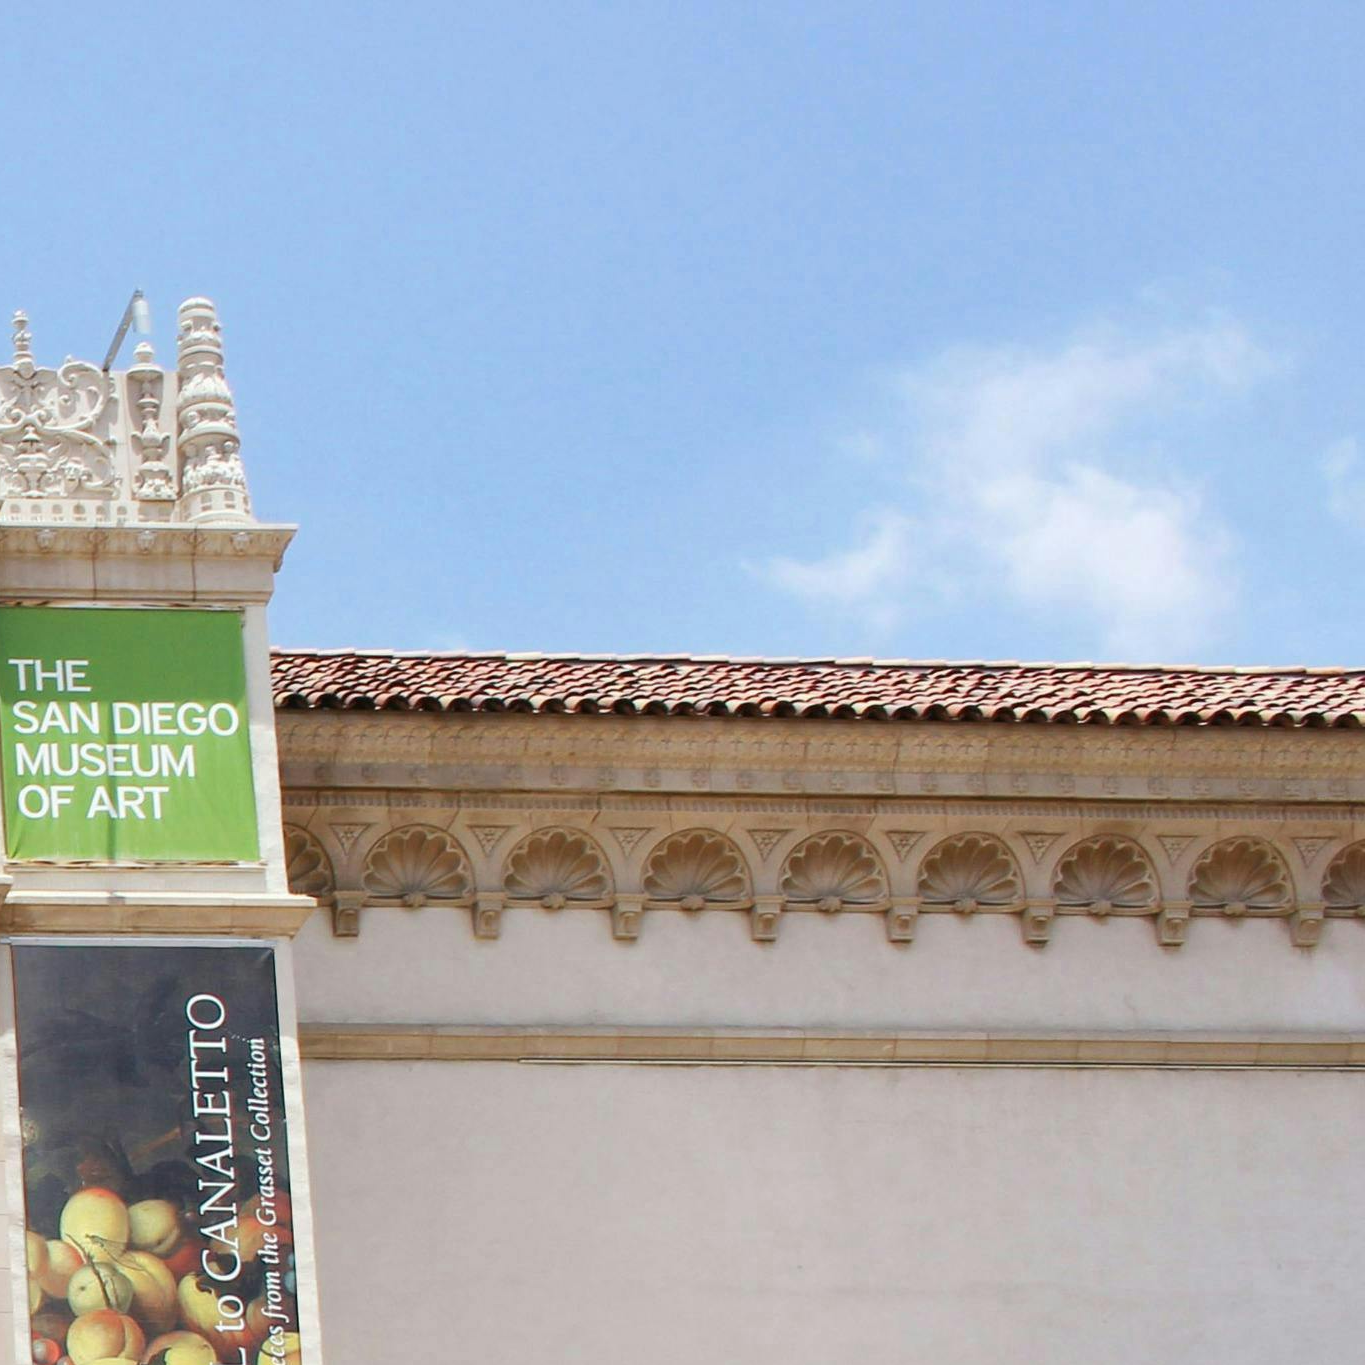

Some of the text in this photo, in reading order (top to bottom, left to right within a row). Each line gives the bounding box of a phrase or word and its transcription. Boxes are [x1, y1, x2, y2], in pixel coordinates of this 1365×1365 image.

[8, 658, 92, 692] THE
[12, 700, 239, 736] SAN DIEGO
[15, 743, 195, 777] MUSEUM
[17, 784, 169, 820] OF ART
[246, 1036, 271, 1142] Collection
[185, 993, 242, 1282] CANALETTO
[255, 1147, 278, 1227] Grasset
[258, 1230, 280, 1264] the
[261, 1264, 290, 1323] from
[217, 1294, 245, 1333] to
